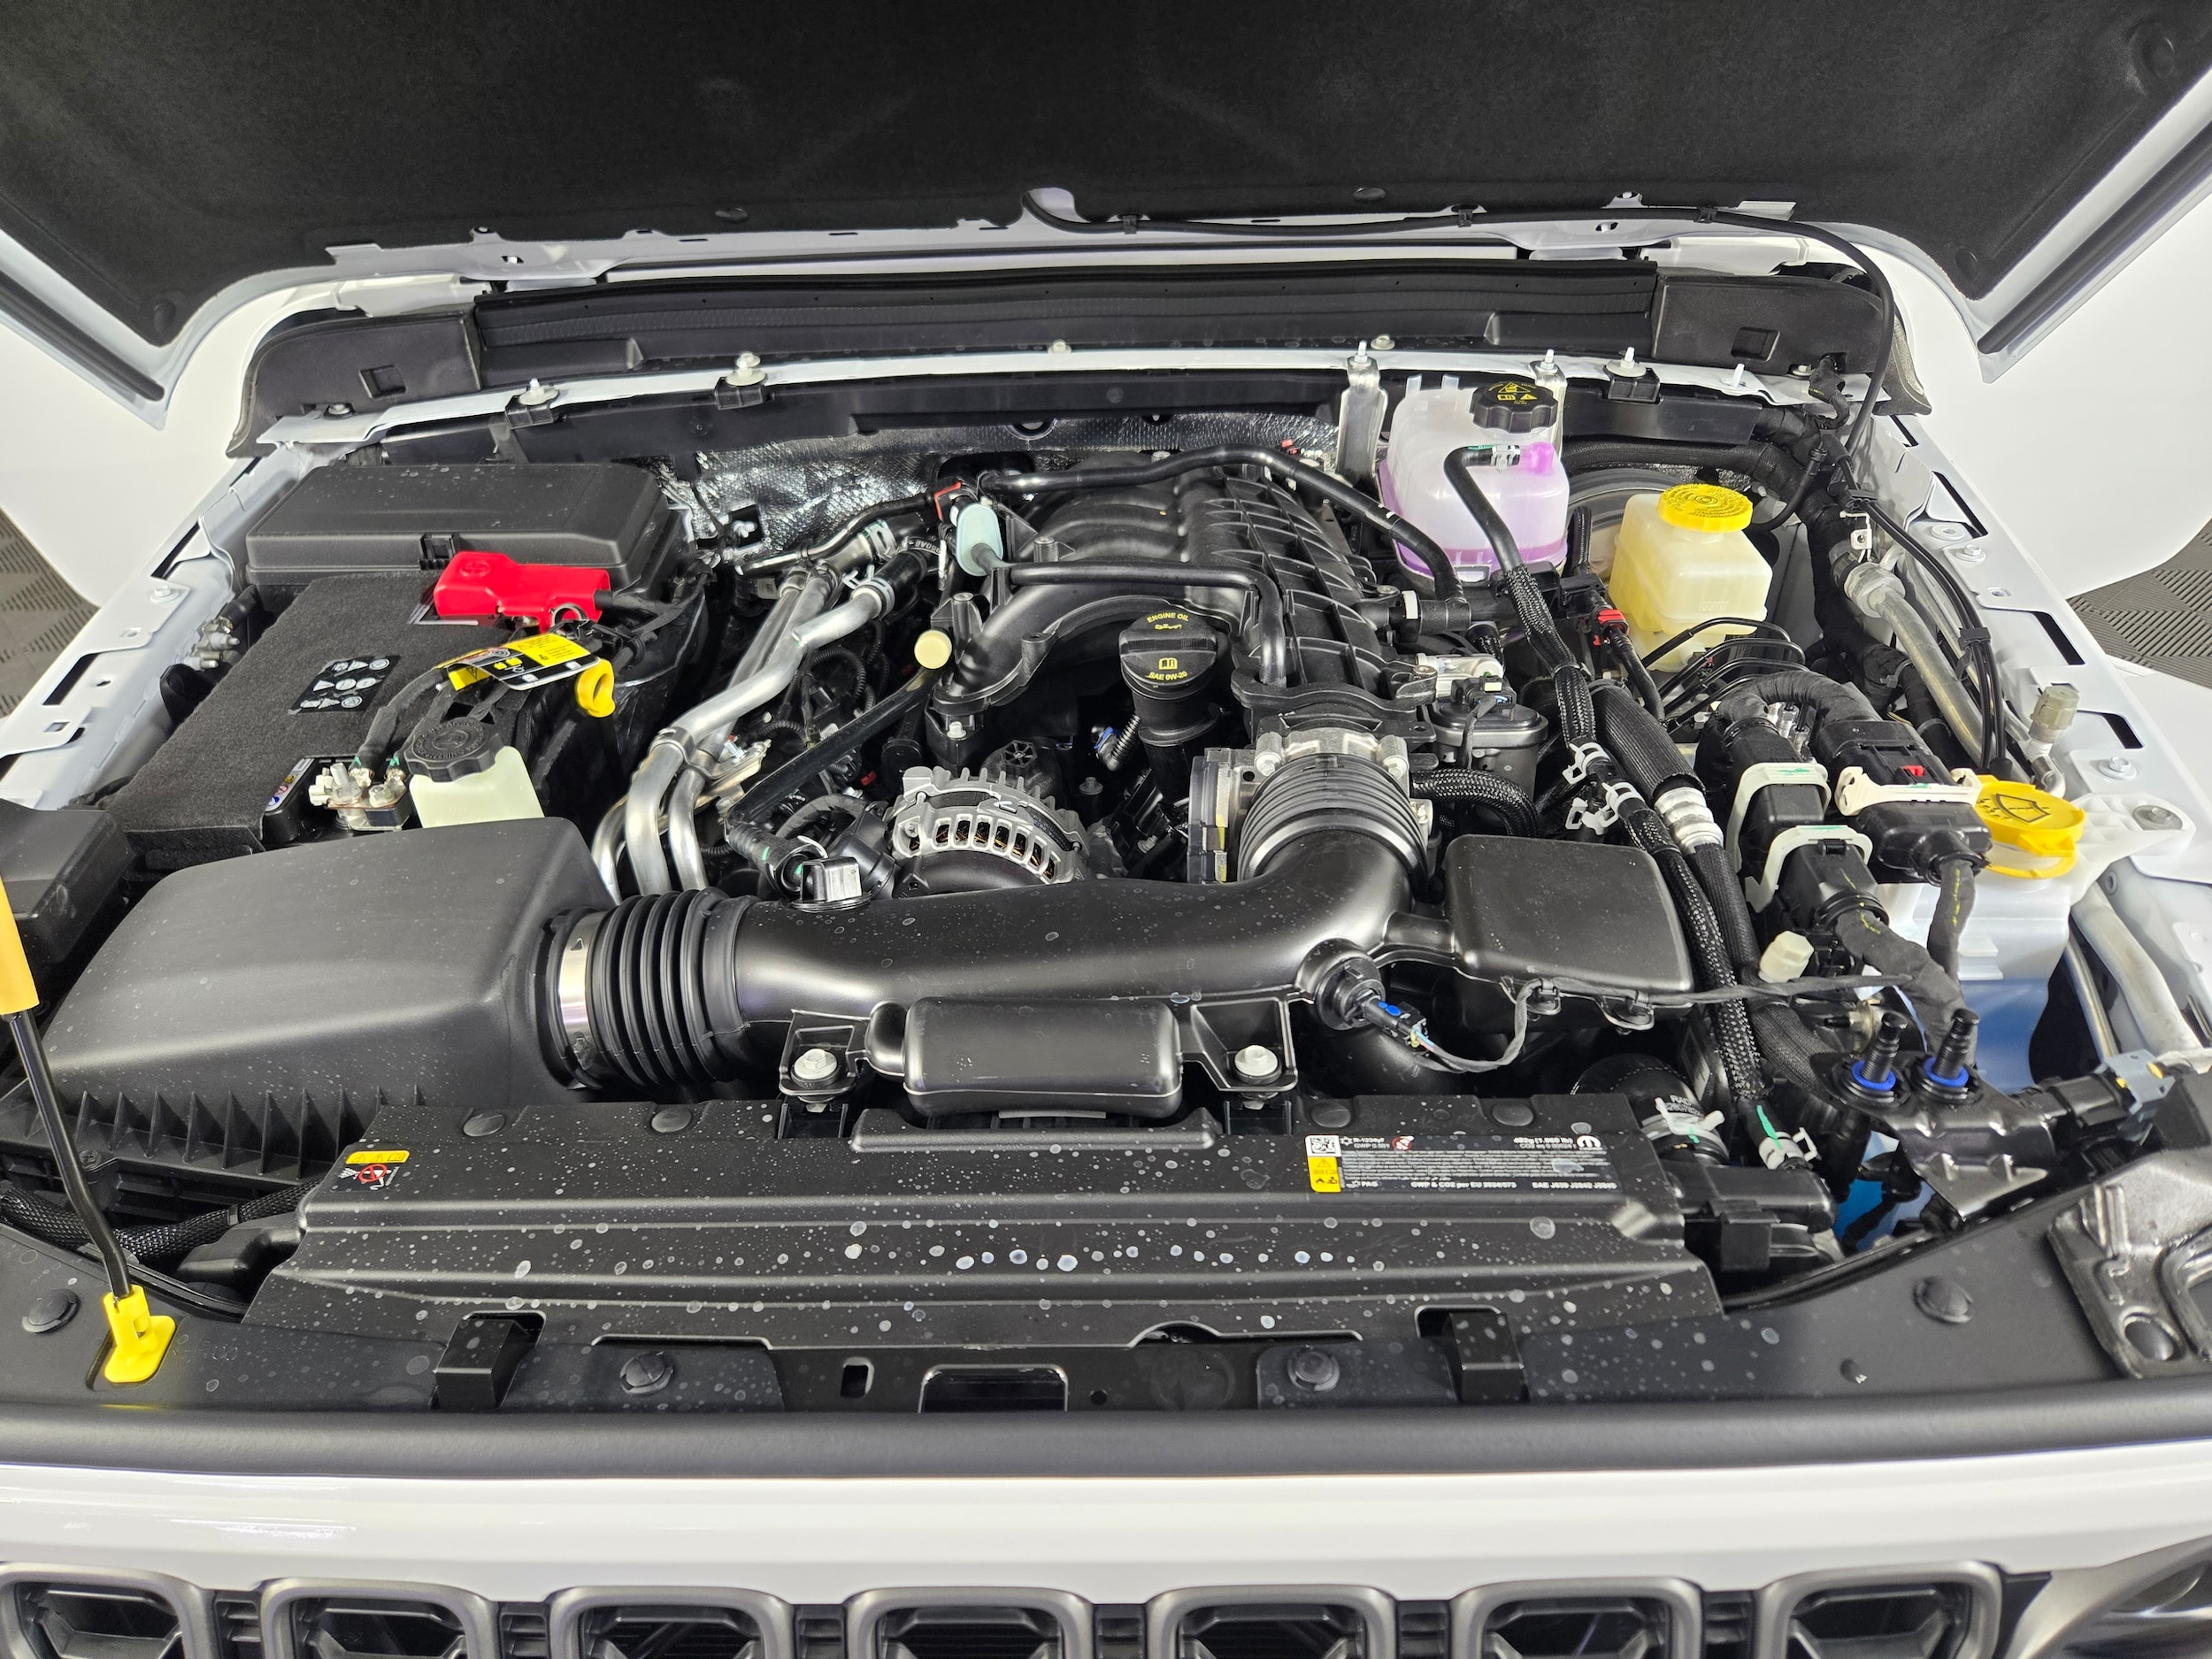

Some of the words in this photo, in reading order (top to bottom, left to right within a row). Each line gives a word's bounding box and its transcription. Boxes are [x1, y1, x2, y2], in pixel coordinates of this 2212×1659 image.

[1147, 612, 1176, 623] ENGINE
[1178, 612, 1189, 621] OIL
[1149, 672, 1164, 680] SAE
[1165, 671, 1187, 680] 0W-20
